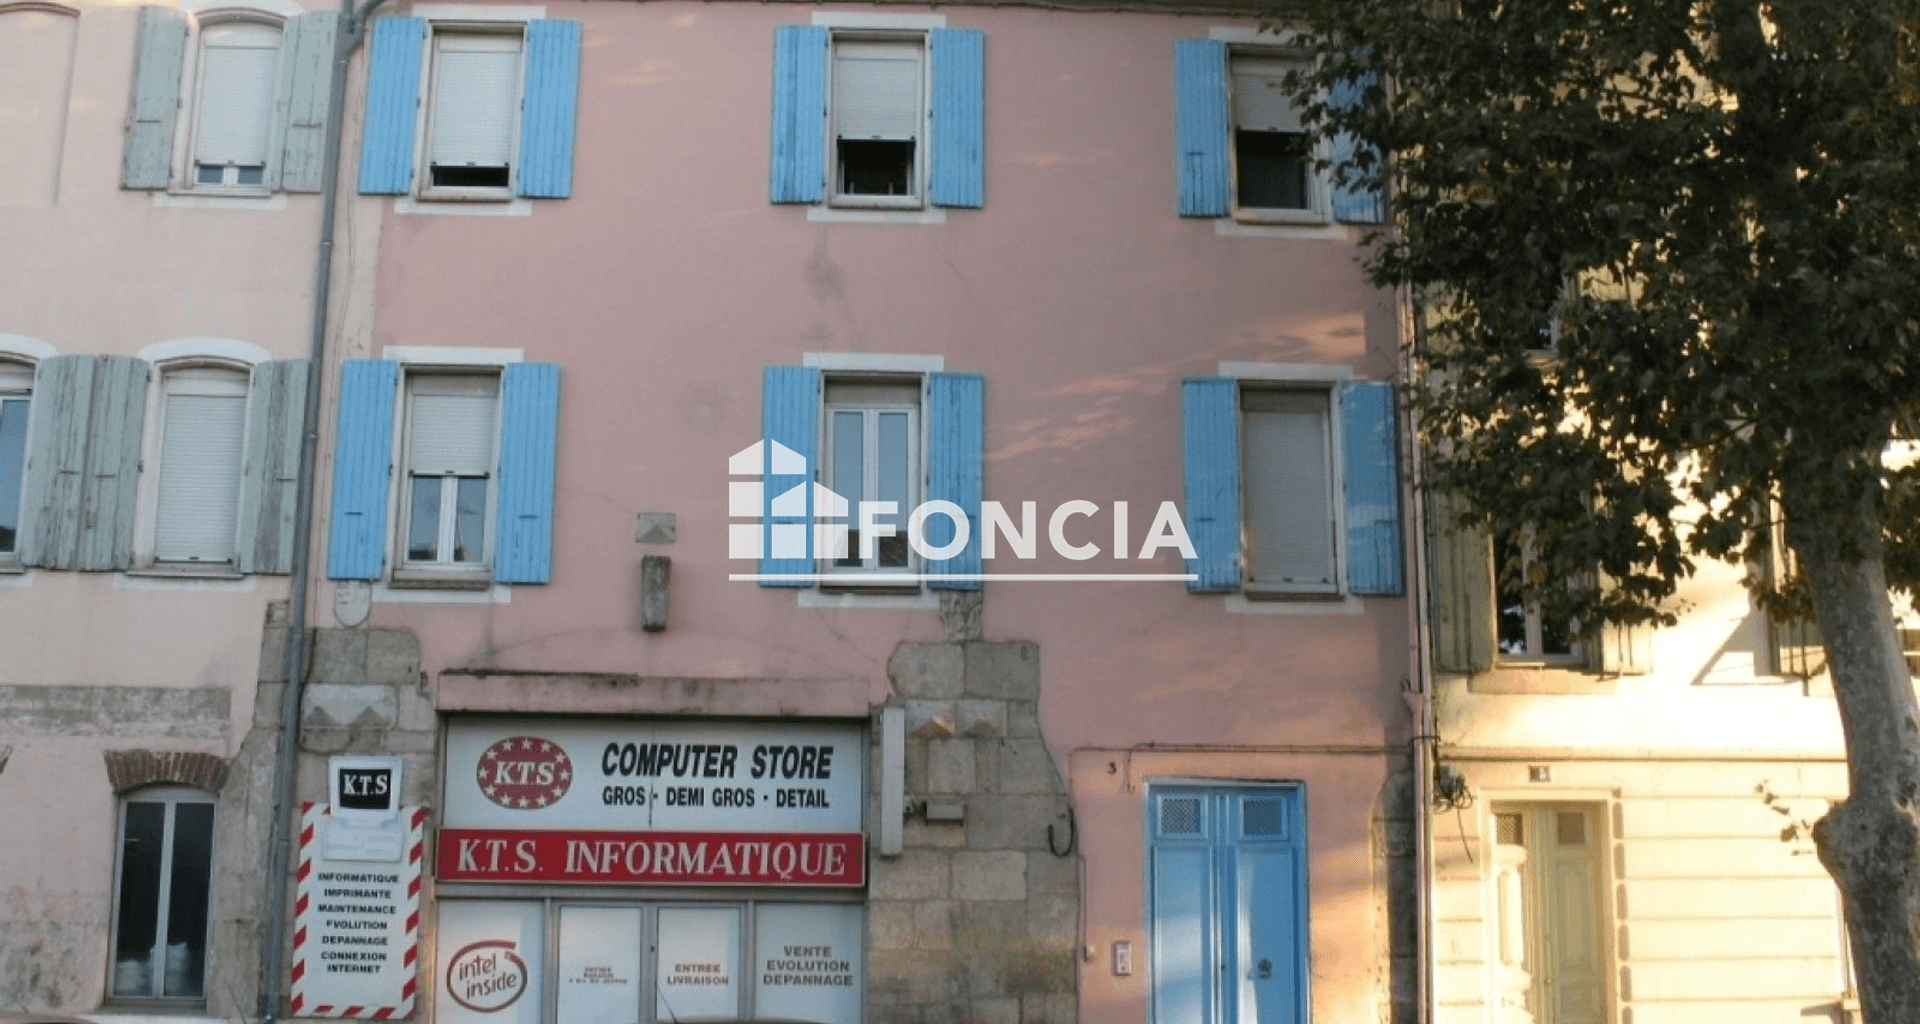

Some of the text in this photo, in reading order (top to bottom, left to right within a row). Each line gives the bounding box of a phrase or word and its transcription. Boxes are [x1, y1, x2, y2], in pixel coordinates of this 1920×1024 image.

[602, 743, 834, 779] COMPUTER STORE
[602, 787, 830, 808] GROS DEMI GROS DETAIL
[457, 838, 846, 880] K.T.S. INFORMATIQUE
[317, 872, 399, 883] INFORMATIQUE
[324, 889, 391, 899] IMPRIMANTE
[318, 904, 397, 914] MAINTENANCE
[322, 936, 388, 946] DEPANNAGE
[320, 951, 388, 961] CONNEXION
[784, 945, 832, 957] VENTE
[327, 964, 381, 973] INTERNET
[459, 953, 496, 981] intel
[767, 959, 850, 972] EVOLUTION
[467, 972, 517, 1000] inside
[667, 975, 729, 986] LIVRAISON
[763, 974, 853, 986] DEPANNAGE
